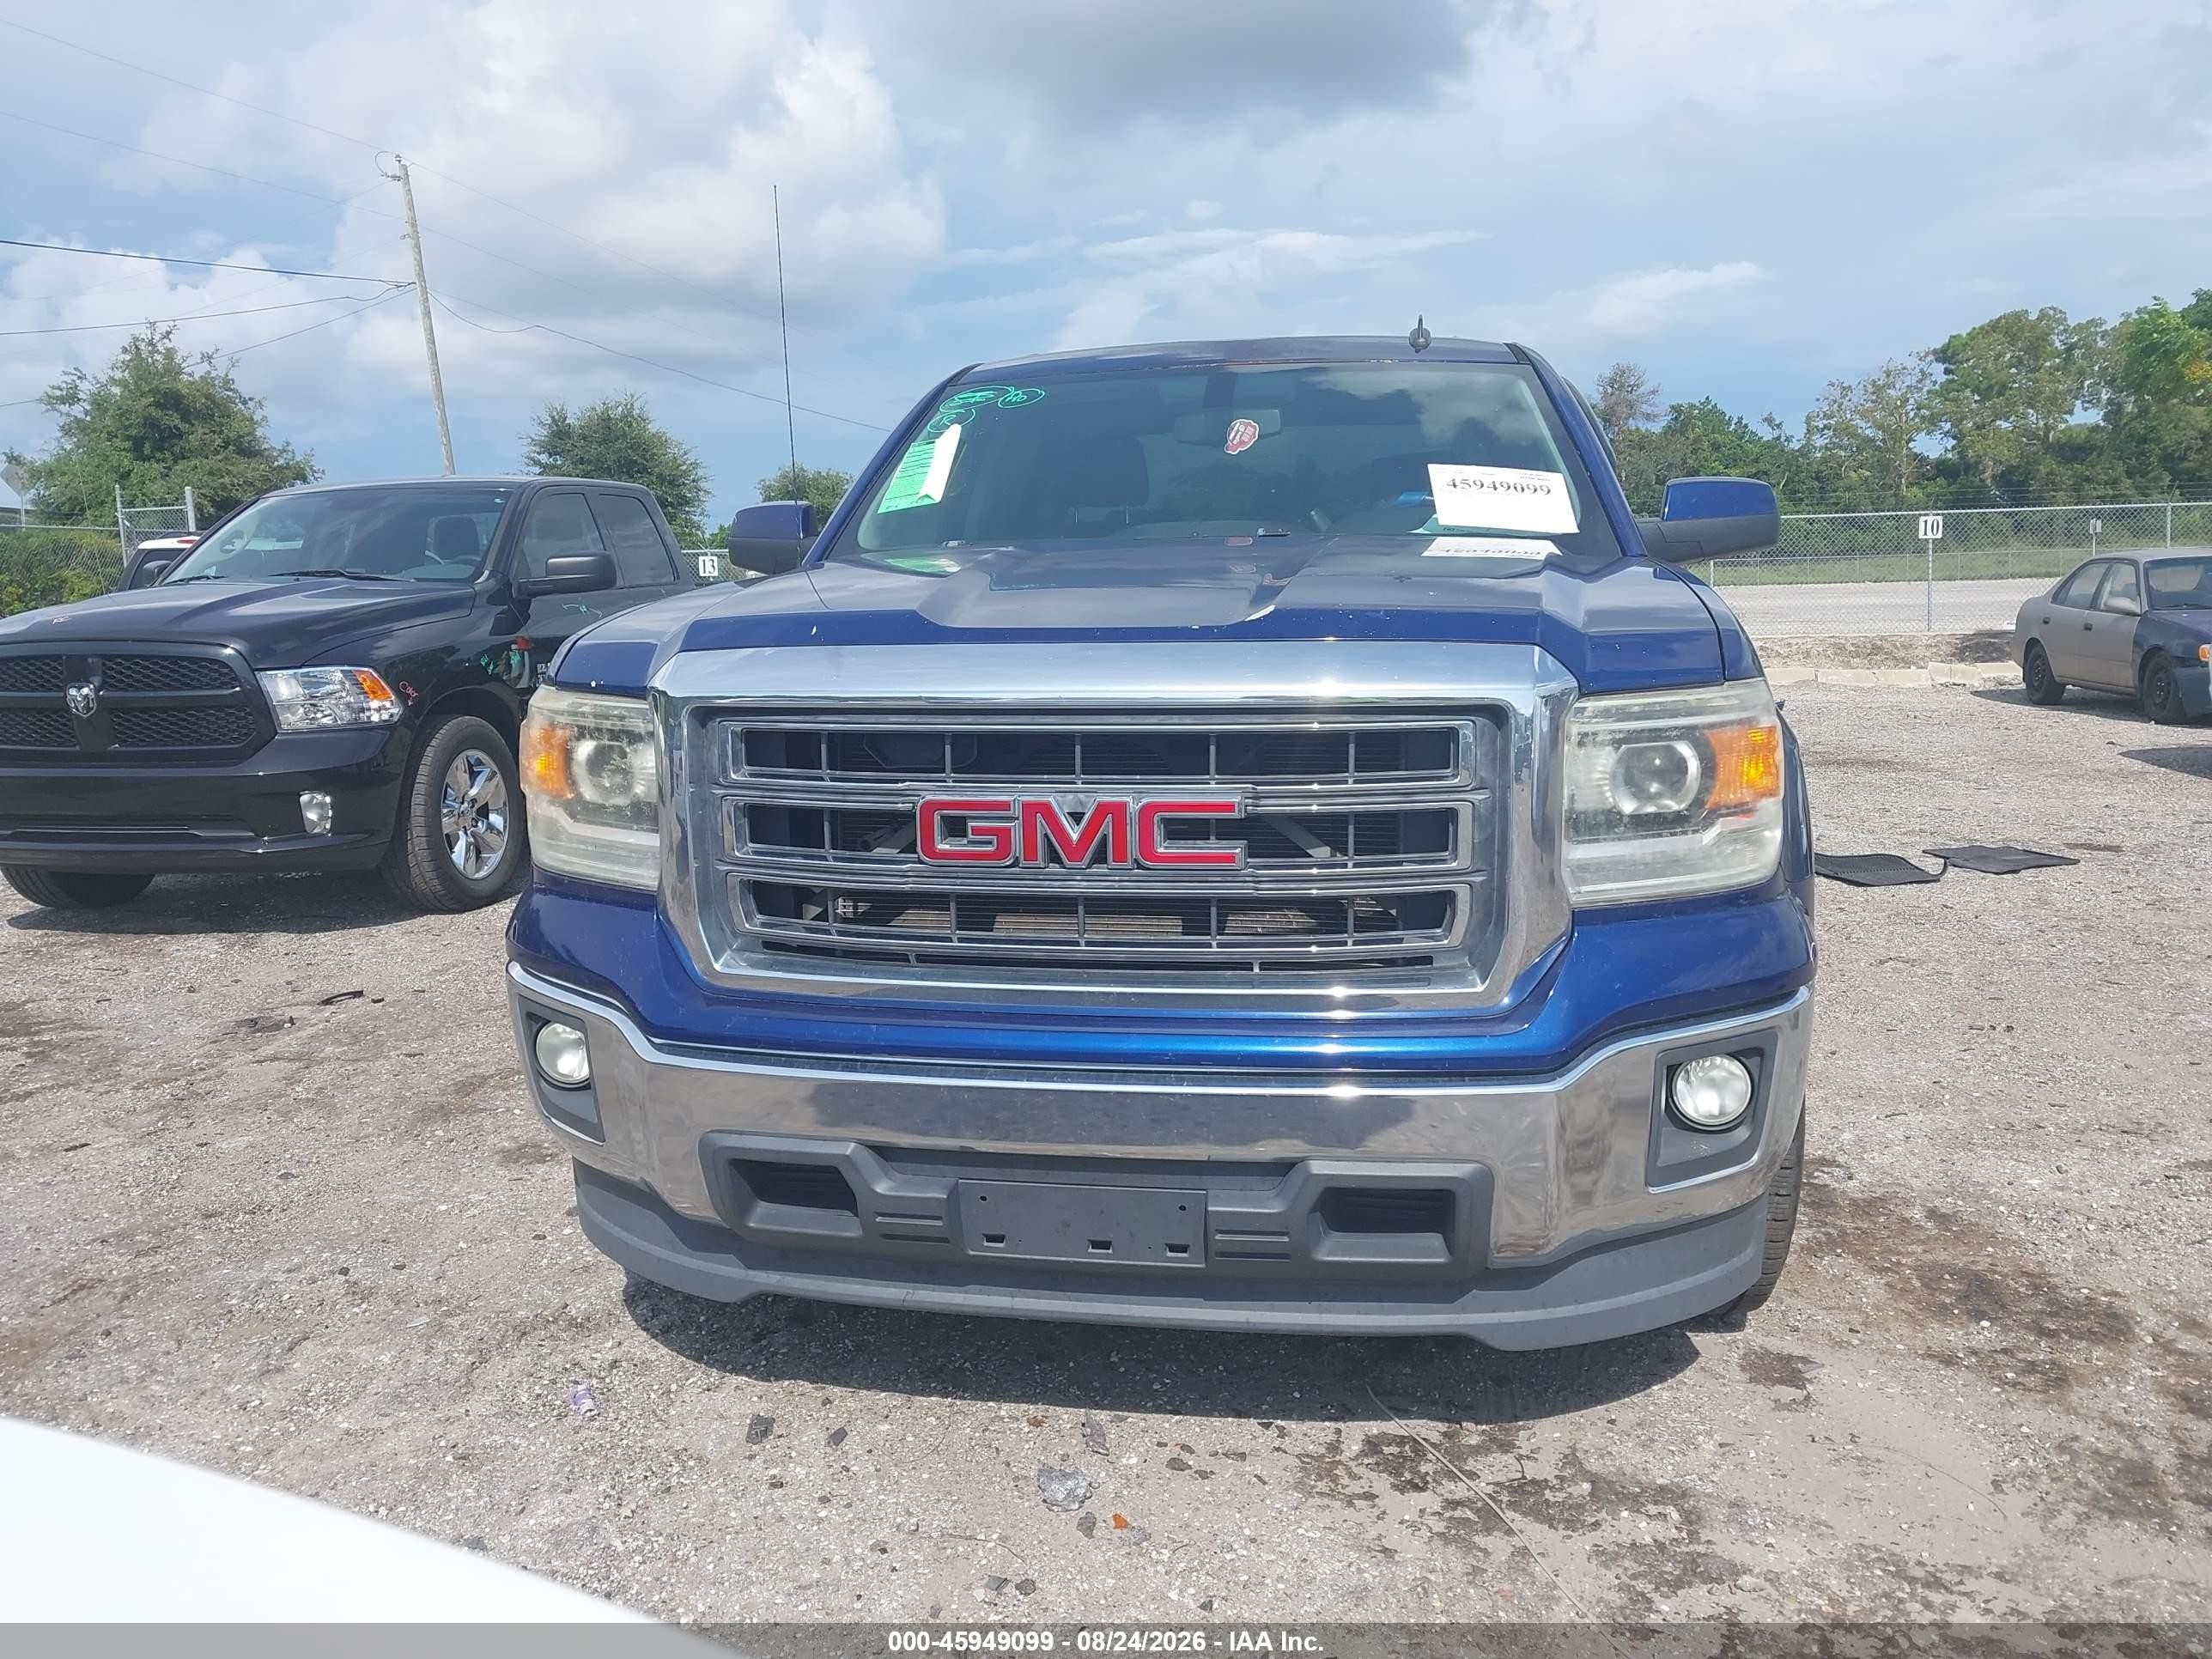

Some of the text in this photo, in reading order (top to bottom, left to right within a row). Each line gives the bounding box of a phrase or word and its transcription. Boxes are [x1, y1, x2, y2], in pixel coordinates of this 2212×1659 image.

[1446, 478, 1552, 495] 45949099
[1923, 519, 1940, 537] 10
[702, 558, 716, 574] 13
[917, 796, 1248, 869] GMC
